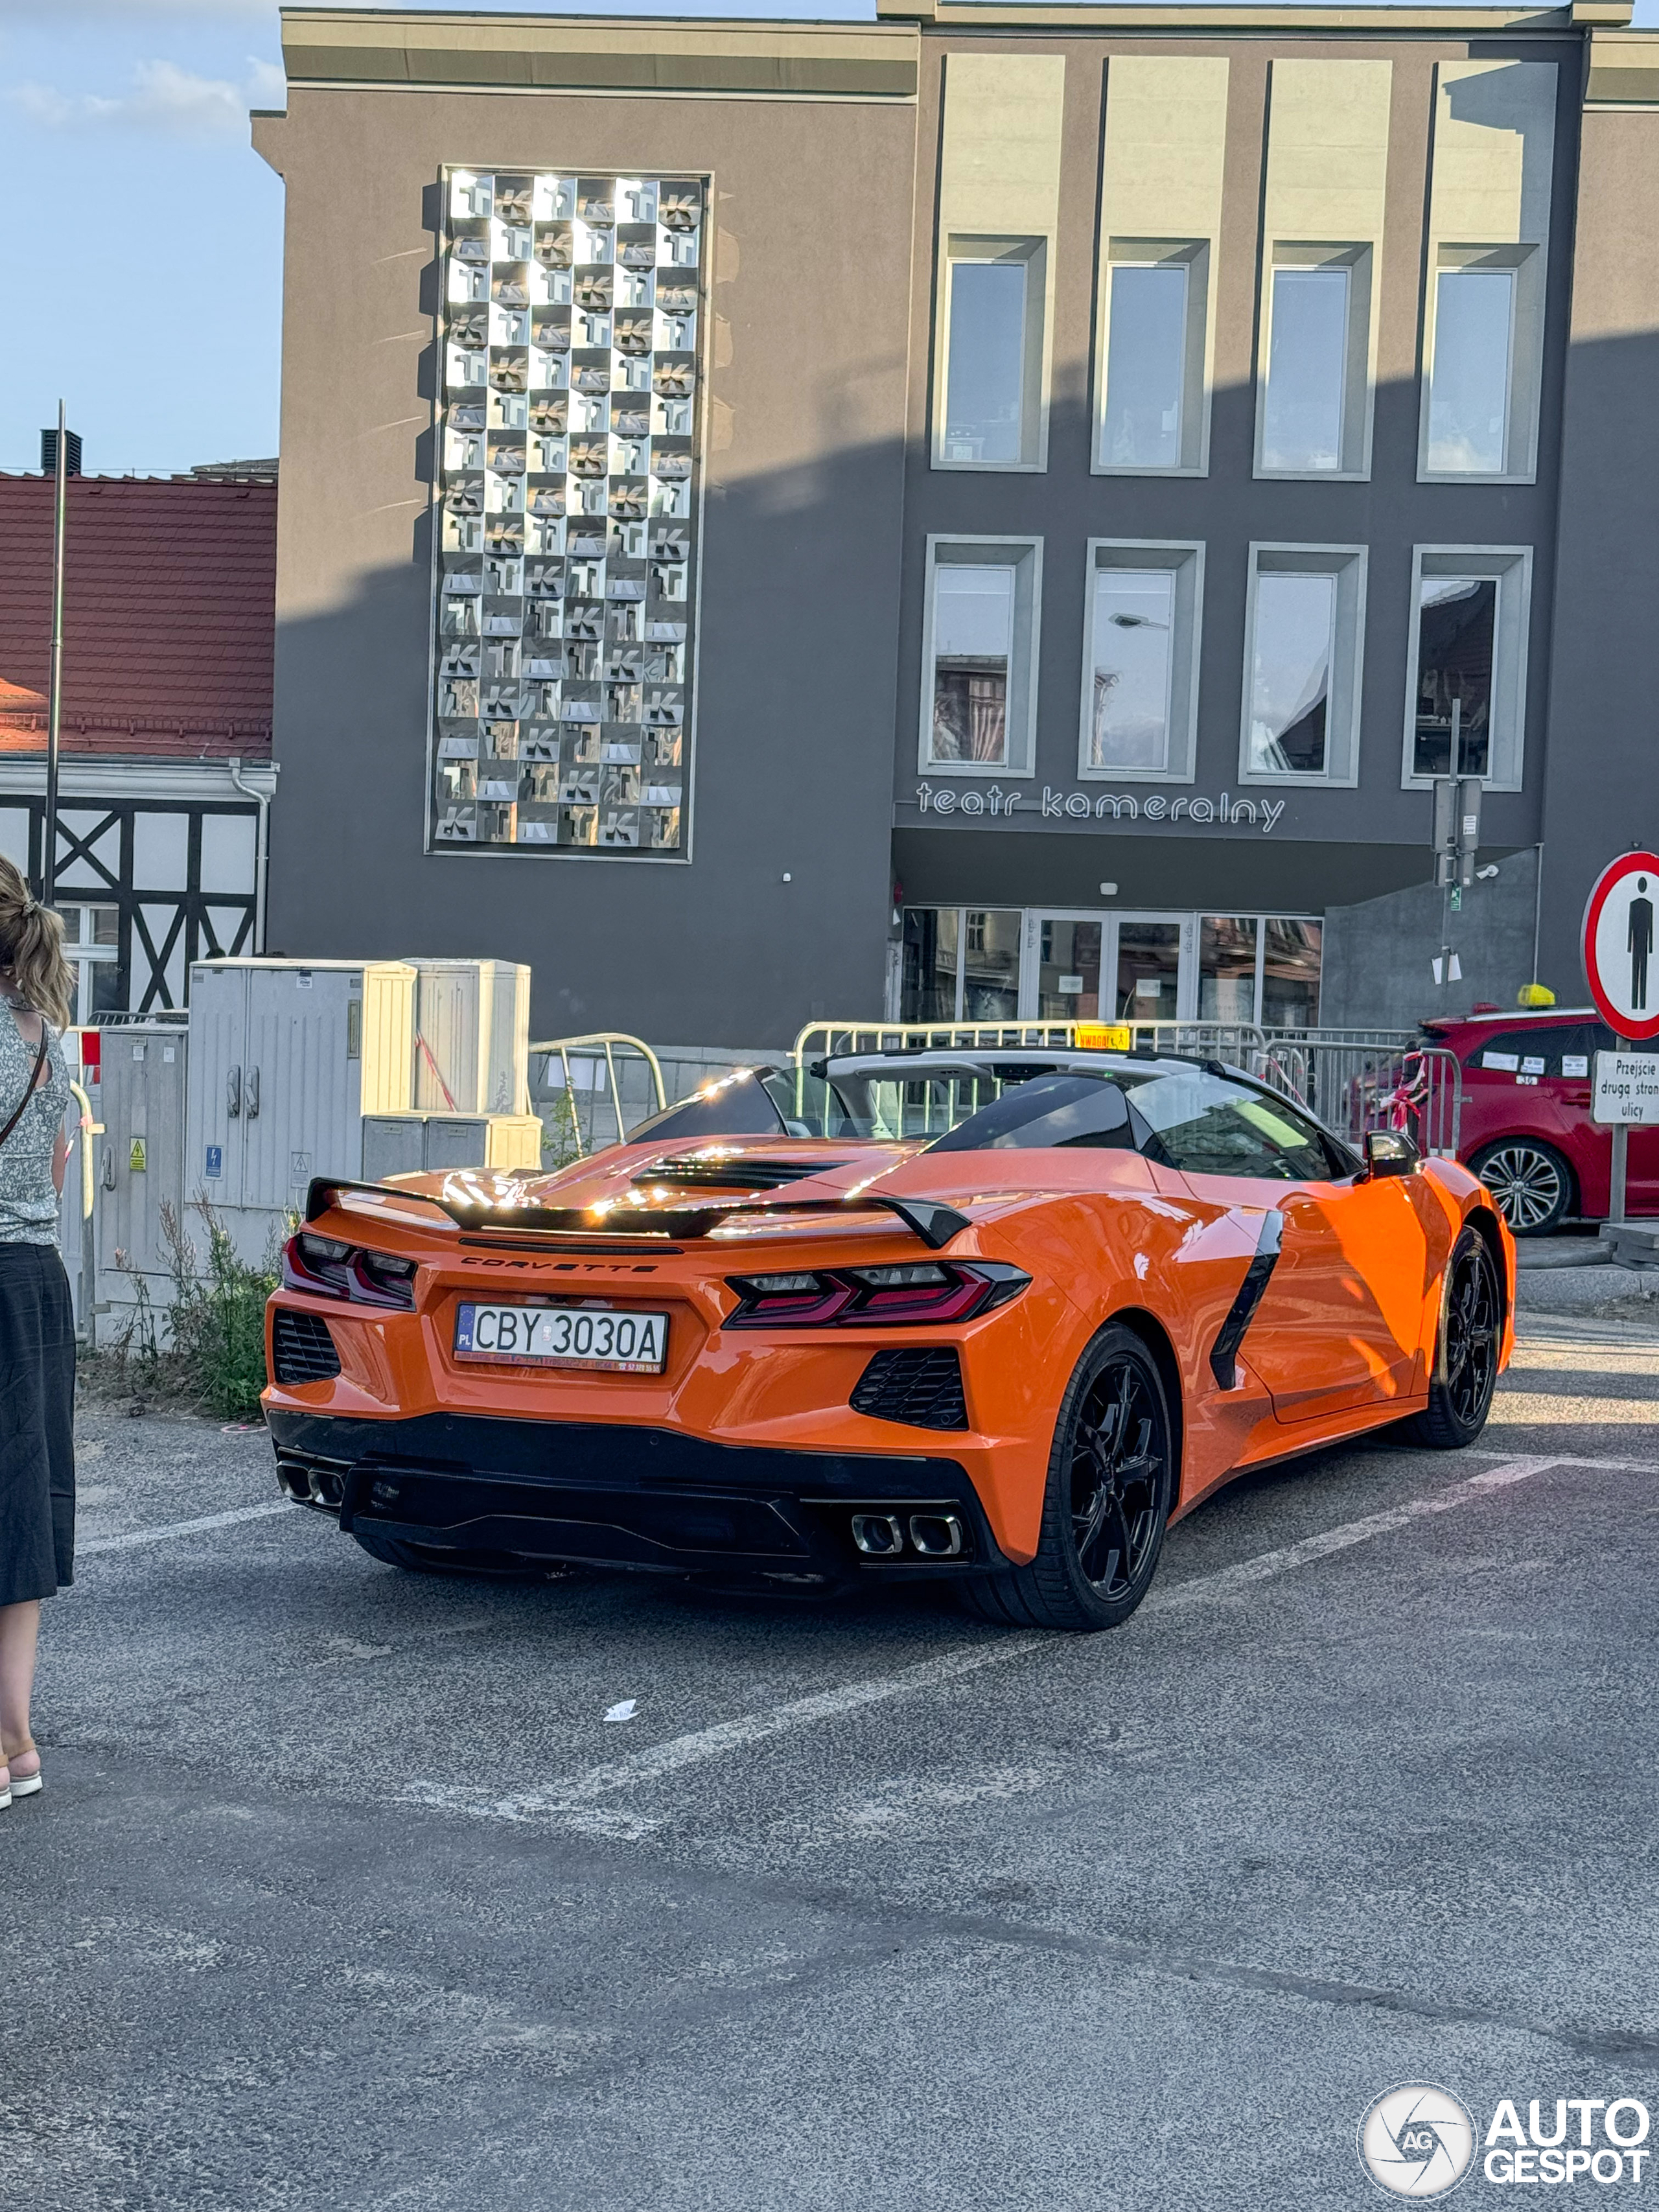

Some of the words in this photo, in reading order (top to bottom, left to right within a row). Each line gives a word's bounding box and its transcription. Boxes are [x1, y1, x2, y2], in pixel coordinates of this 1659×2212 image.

[916, 782, 1021, 816] teatr
[1042, 786, 1285, 833] kameralny
[1616, 1060, 1656, 1079] Przejście
[1601, 1079, 1630, 1099] drugą
[1621, 1102, 1644, 1121] ulicy
[461, 1257, 659, 1273] CORVETTE
[458, 1334, 471, 1346] PL
[476, 1310, 542, 1352] CBY
[553, 1314, 656, 1360] 3030A
